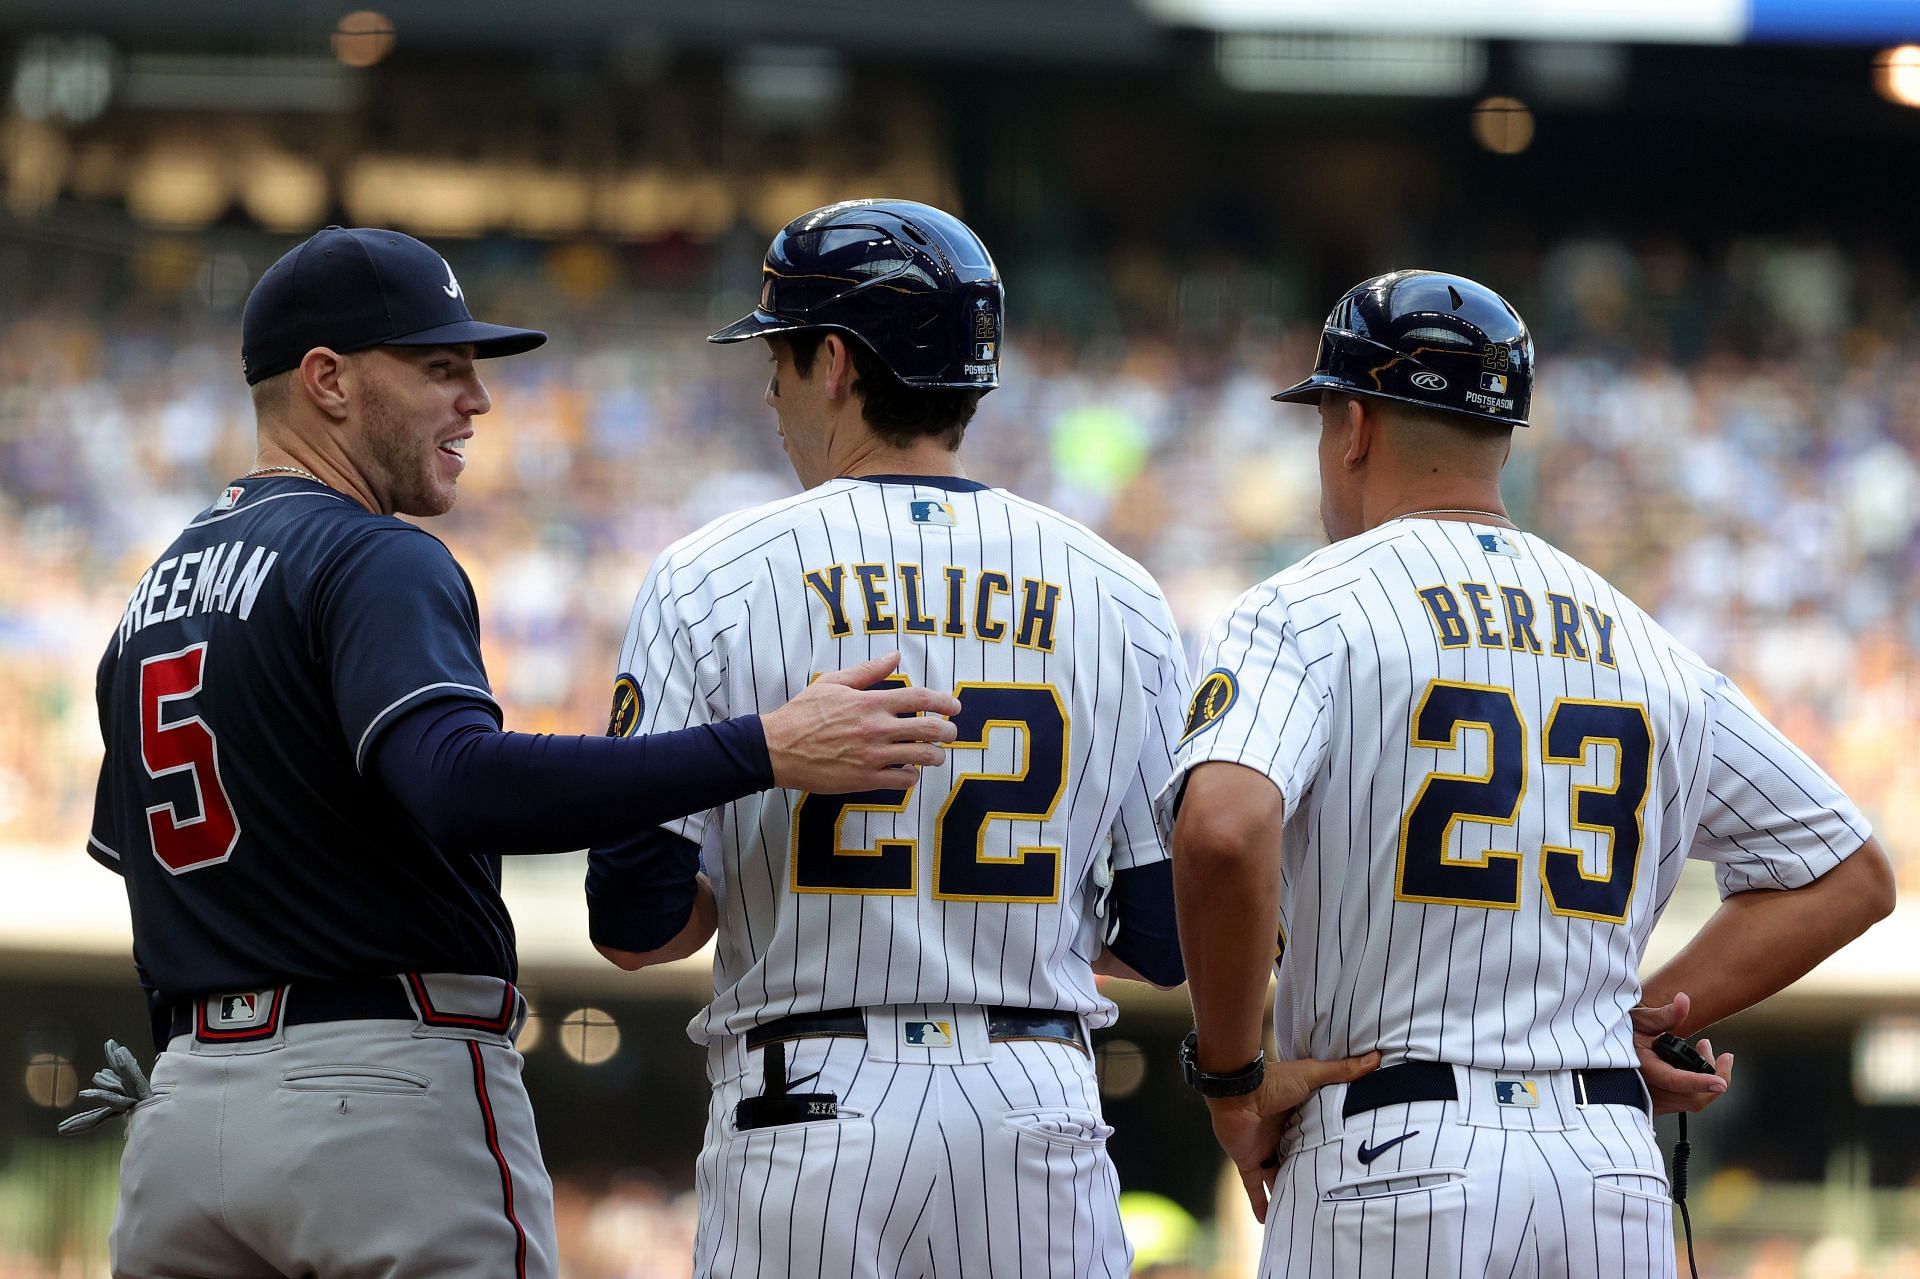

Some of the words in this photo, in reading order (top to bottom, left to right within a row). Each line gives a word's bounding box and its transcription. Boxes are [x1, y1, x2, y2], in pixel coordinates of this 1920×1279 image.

[1465, 390, 1514, 411] POSTSEASON
[1482, 343, 1509, 372] 23
[803, 562, 1062, 655] YELICH
[1414, 580, 1618, 670] BERRY
[139, 640, 242, 877] 5
[1393, 677, 1656, 926] 23
